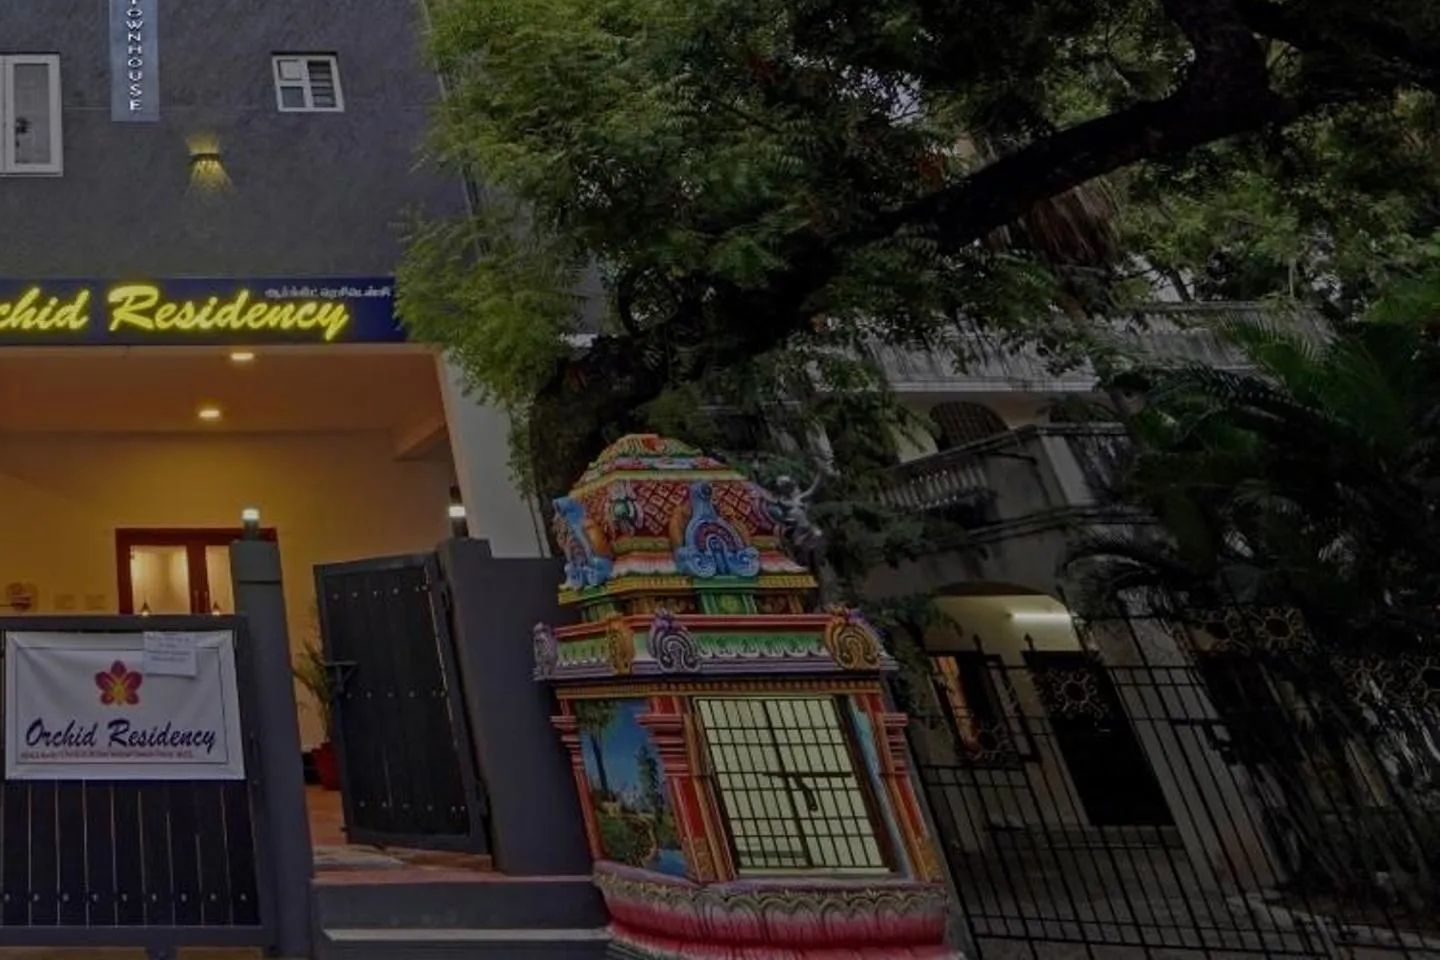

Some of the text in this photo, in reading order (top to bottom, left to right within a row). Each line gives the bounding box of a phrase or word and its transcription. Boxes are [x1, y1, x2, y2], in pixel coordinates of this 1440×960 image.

[107, 284, 351, 342] Residency
[25, 717, 217, 754] Orchid Residency
